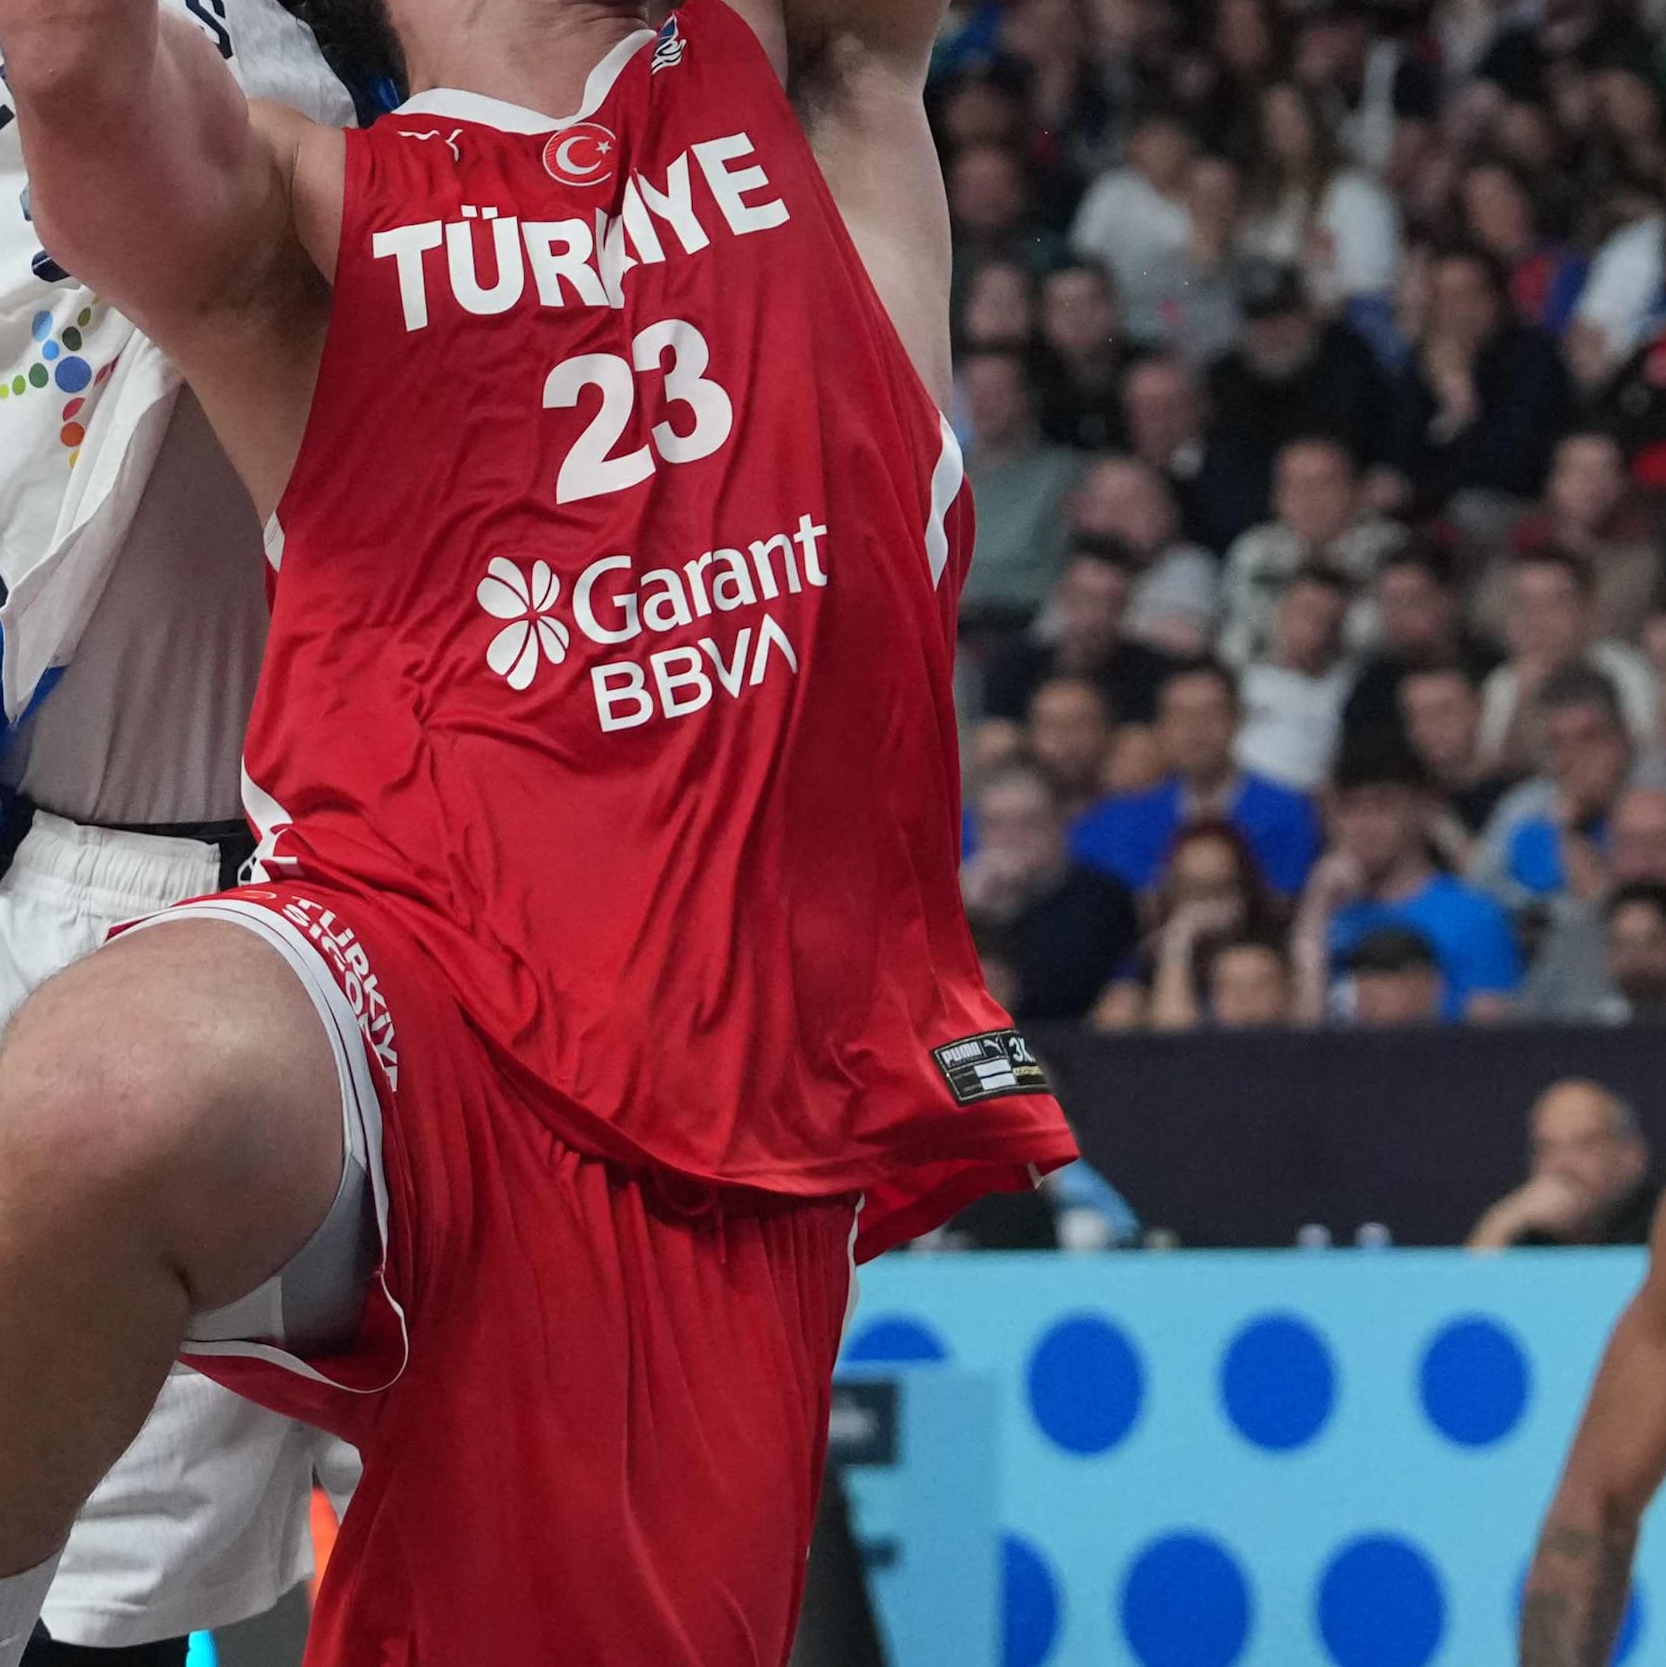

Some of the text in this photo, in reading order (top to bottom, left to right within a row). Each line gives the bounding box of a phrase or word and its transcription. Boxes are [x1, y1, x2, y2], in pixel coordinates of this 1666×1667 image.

[542, 317, 733, 505] 23
[572, 513, 828, 645] Garant
[590, 613, 799, 733] BBVA
